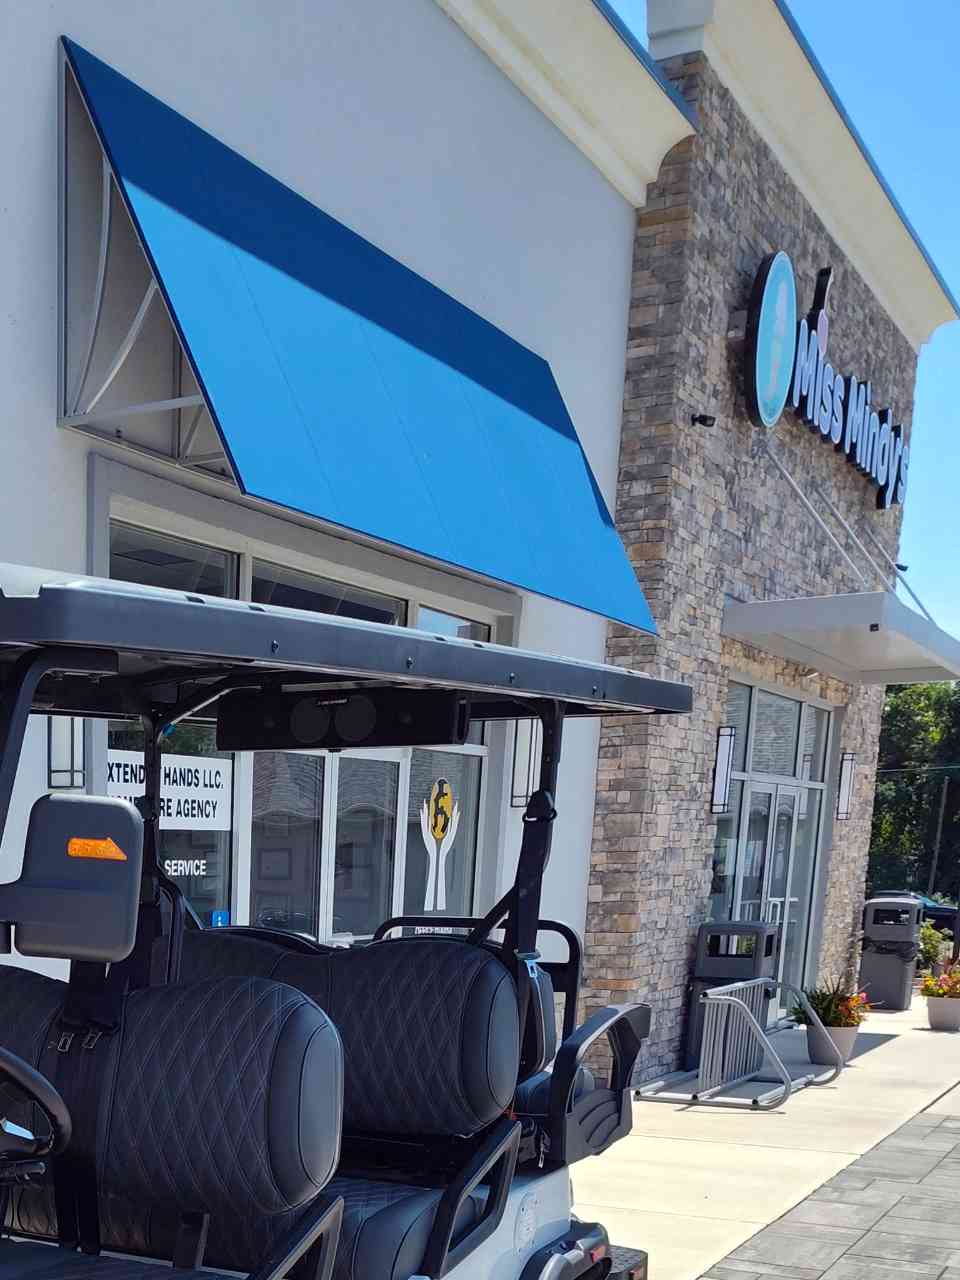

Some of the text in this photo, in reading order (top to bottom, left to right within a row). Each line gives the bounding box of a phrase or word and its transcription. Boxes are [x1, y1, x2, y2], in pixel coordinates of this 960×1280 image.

[793, 312, 845, 445] Miss
[164, 766, 200, 788] HANDS
[176, 799, 218, 819] AGENCY
[164, 859, 207, 876] SERVICE
